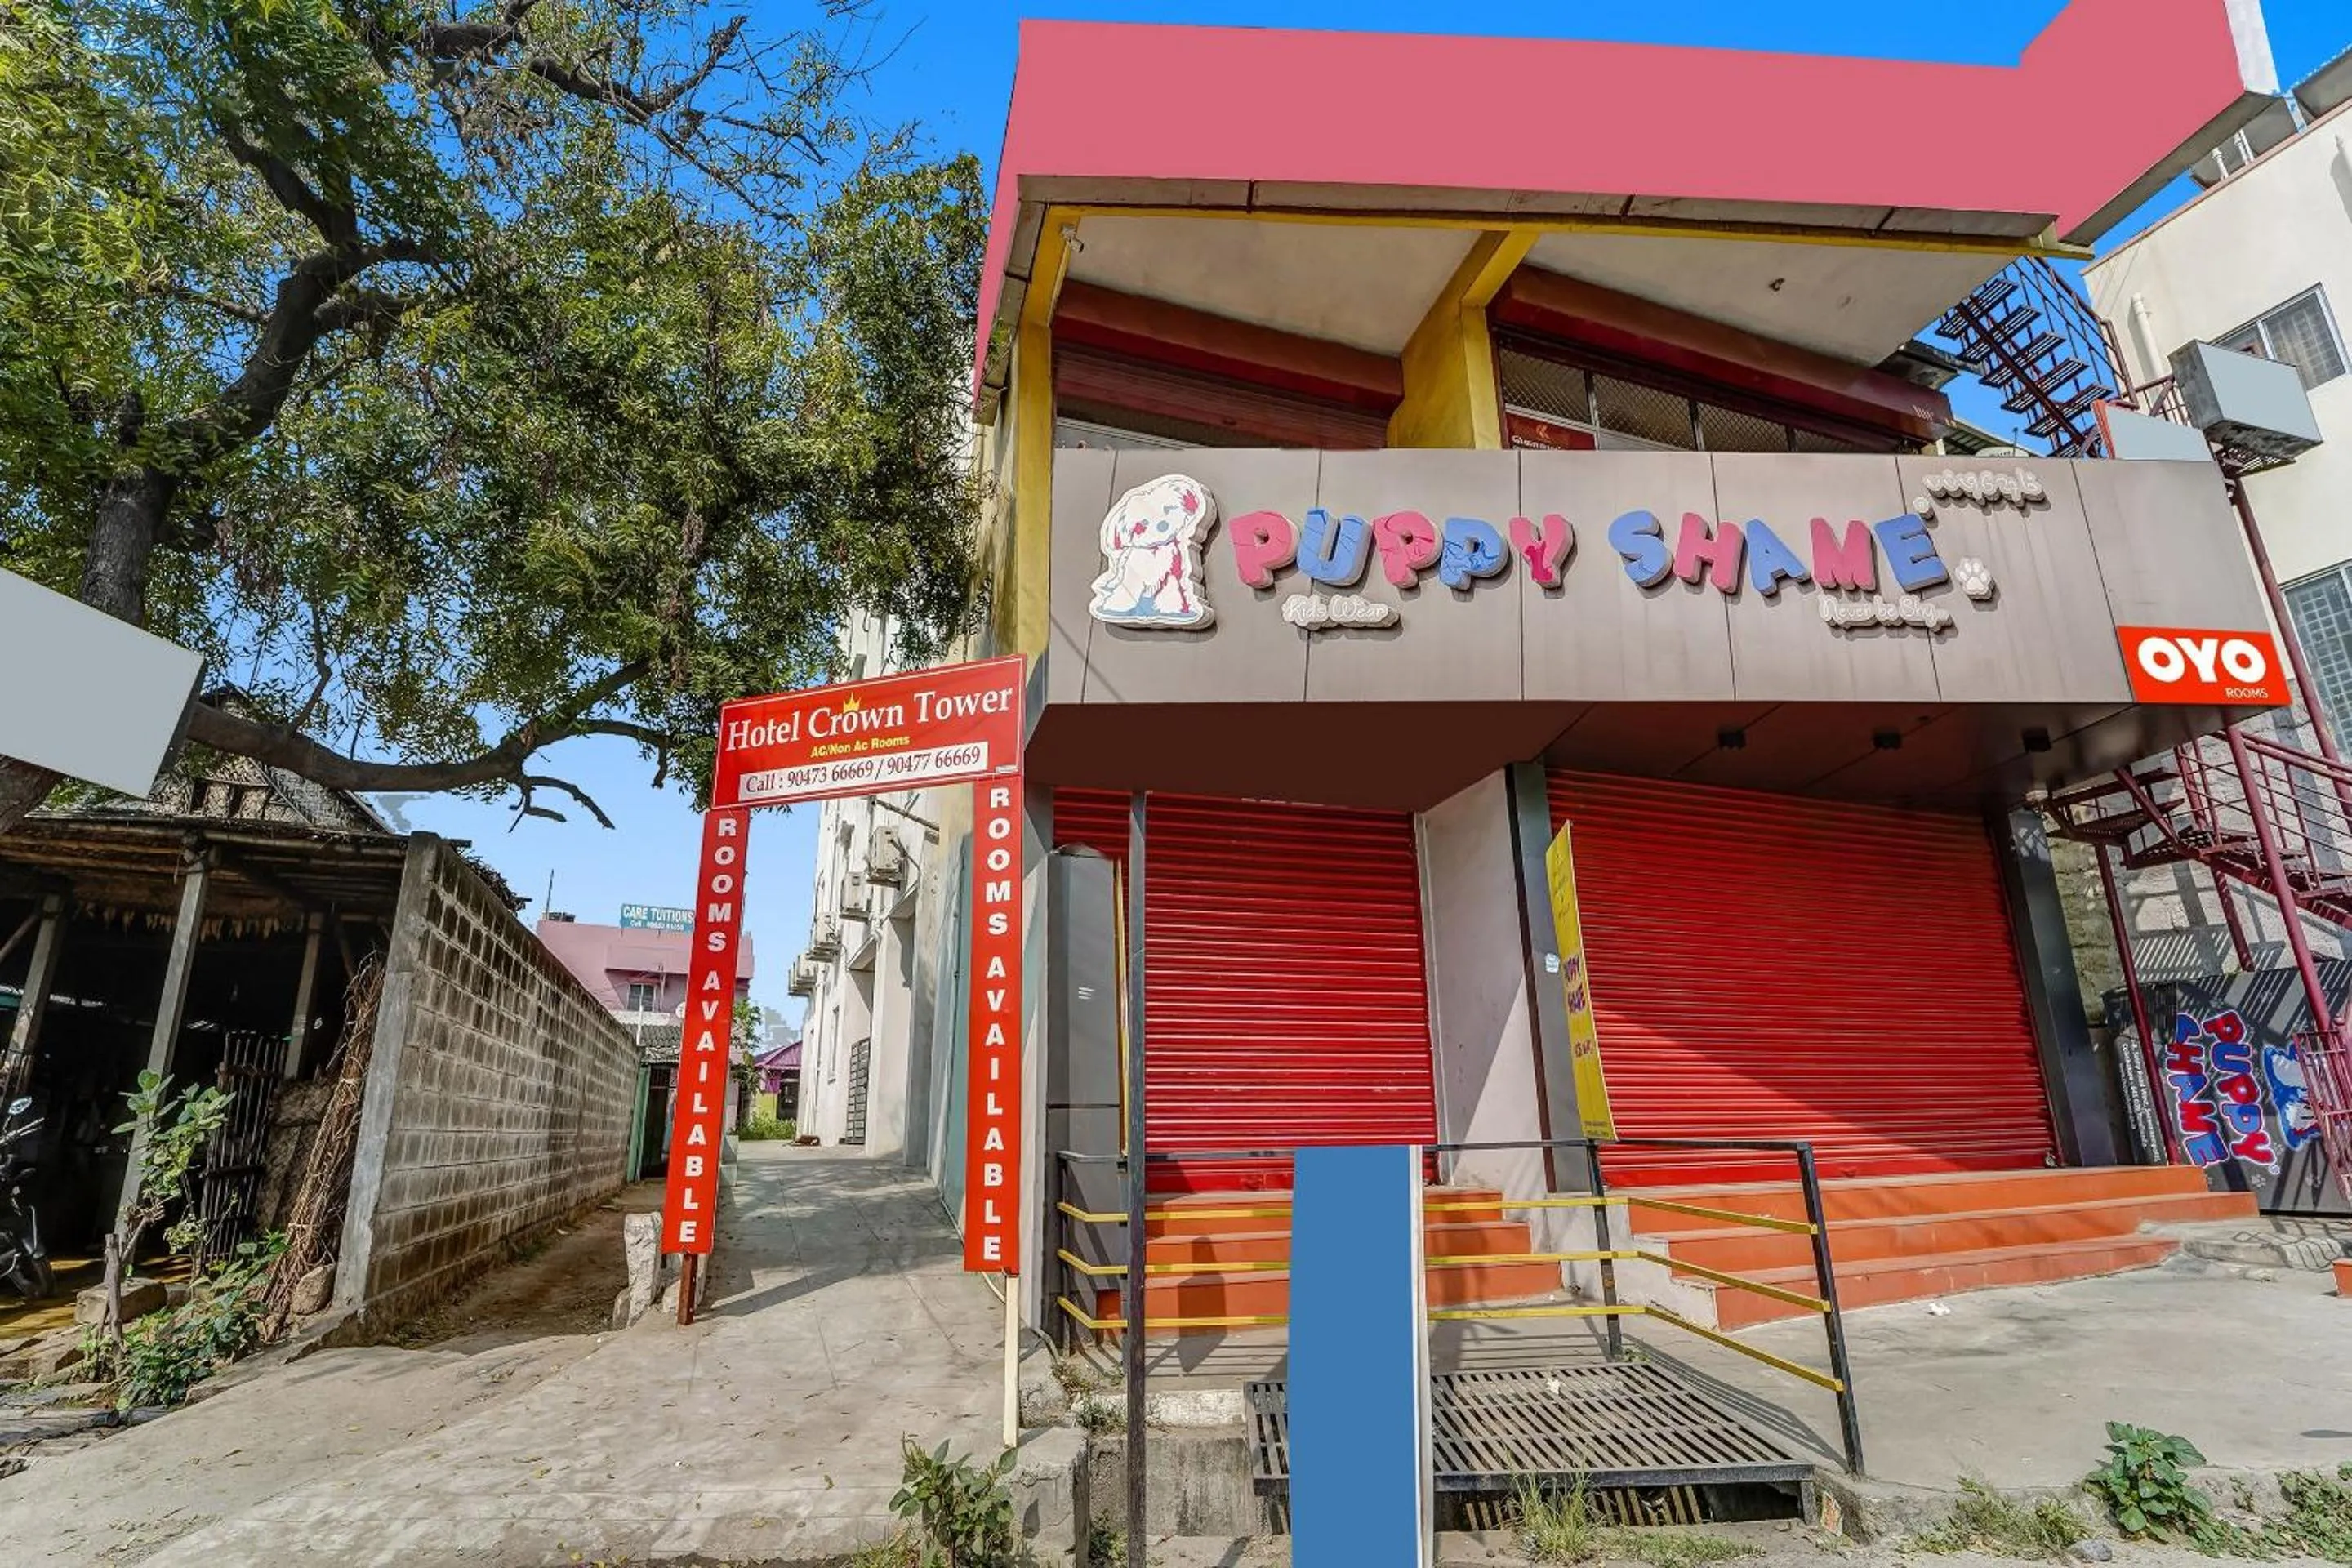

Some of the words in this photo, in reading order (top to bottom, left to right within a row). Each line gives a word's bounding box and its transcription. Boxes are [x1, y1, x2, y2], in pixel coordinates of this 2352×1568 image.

[1229, 506, 1578, 591] PUPPY
[1608, 510, 1950, 596] SHAME
[1285, 595, 1328, 625] Kids
[1330, 595, 1388, 622] Wear
[1820, 595, 1872, 623] Never
[1874, 595, 1897, 620] be
[2137, 636, 2267, 684] OYO
[725, 710, 800, 751] Hotel
[808, 702, 904, 738] Crown
[914, 688, 1013, 724] Tower
[2225, 688, 2269, 699] ROOMS
[746, 773, 776, 793] Call
[787, 767, 827, 789] 90473
[831, 760, 874, 782] 66669
[886, 753, 932, 776] 90477
[935, 745, 981, 769] 66669
[853, 740, 868, 752] Ac
[871, 736, 911, 750] Rooms
[706, 817, 738, 953] ROOMS
[987, 786, 1011, 936] ROOMS
[623, 906, 648, 920] CARE
[649, 906, 694, 924] TUITIONS
[678, 970, 722, 1244] AVAILABLE
[982, 955, 1007, 1262] AVAILABLE
[2202, 1009, 2276, 1165] PUPPY
